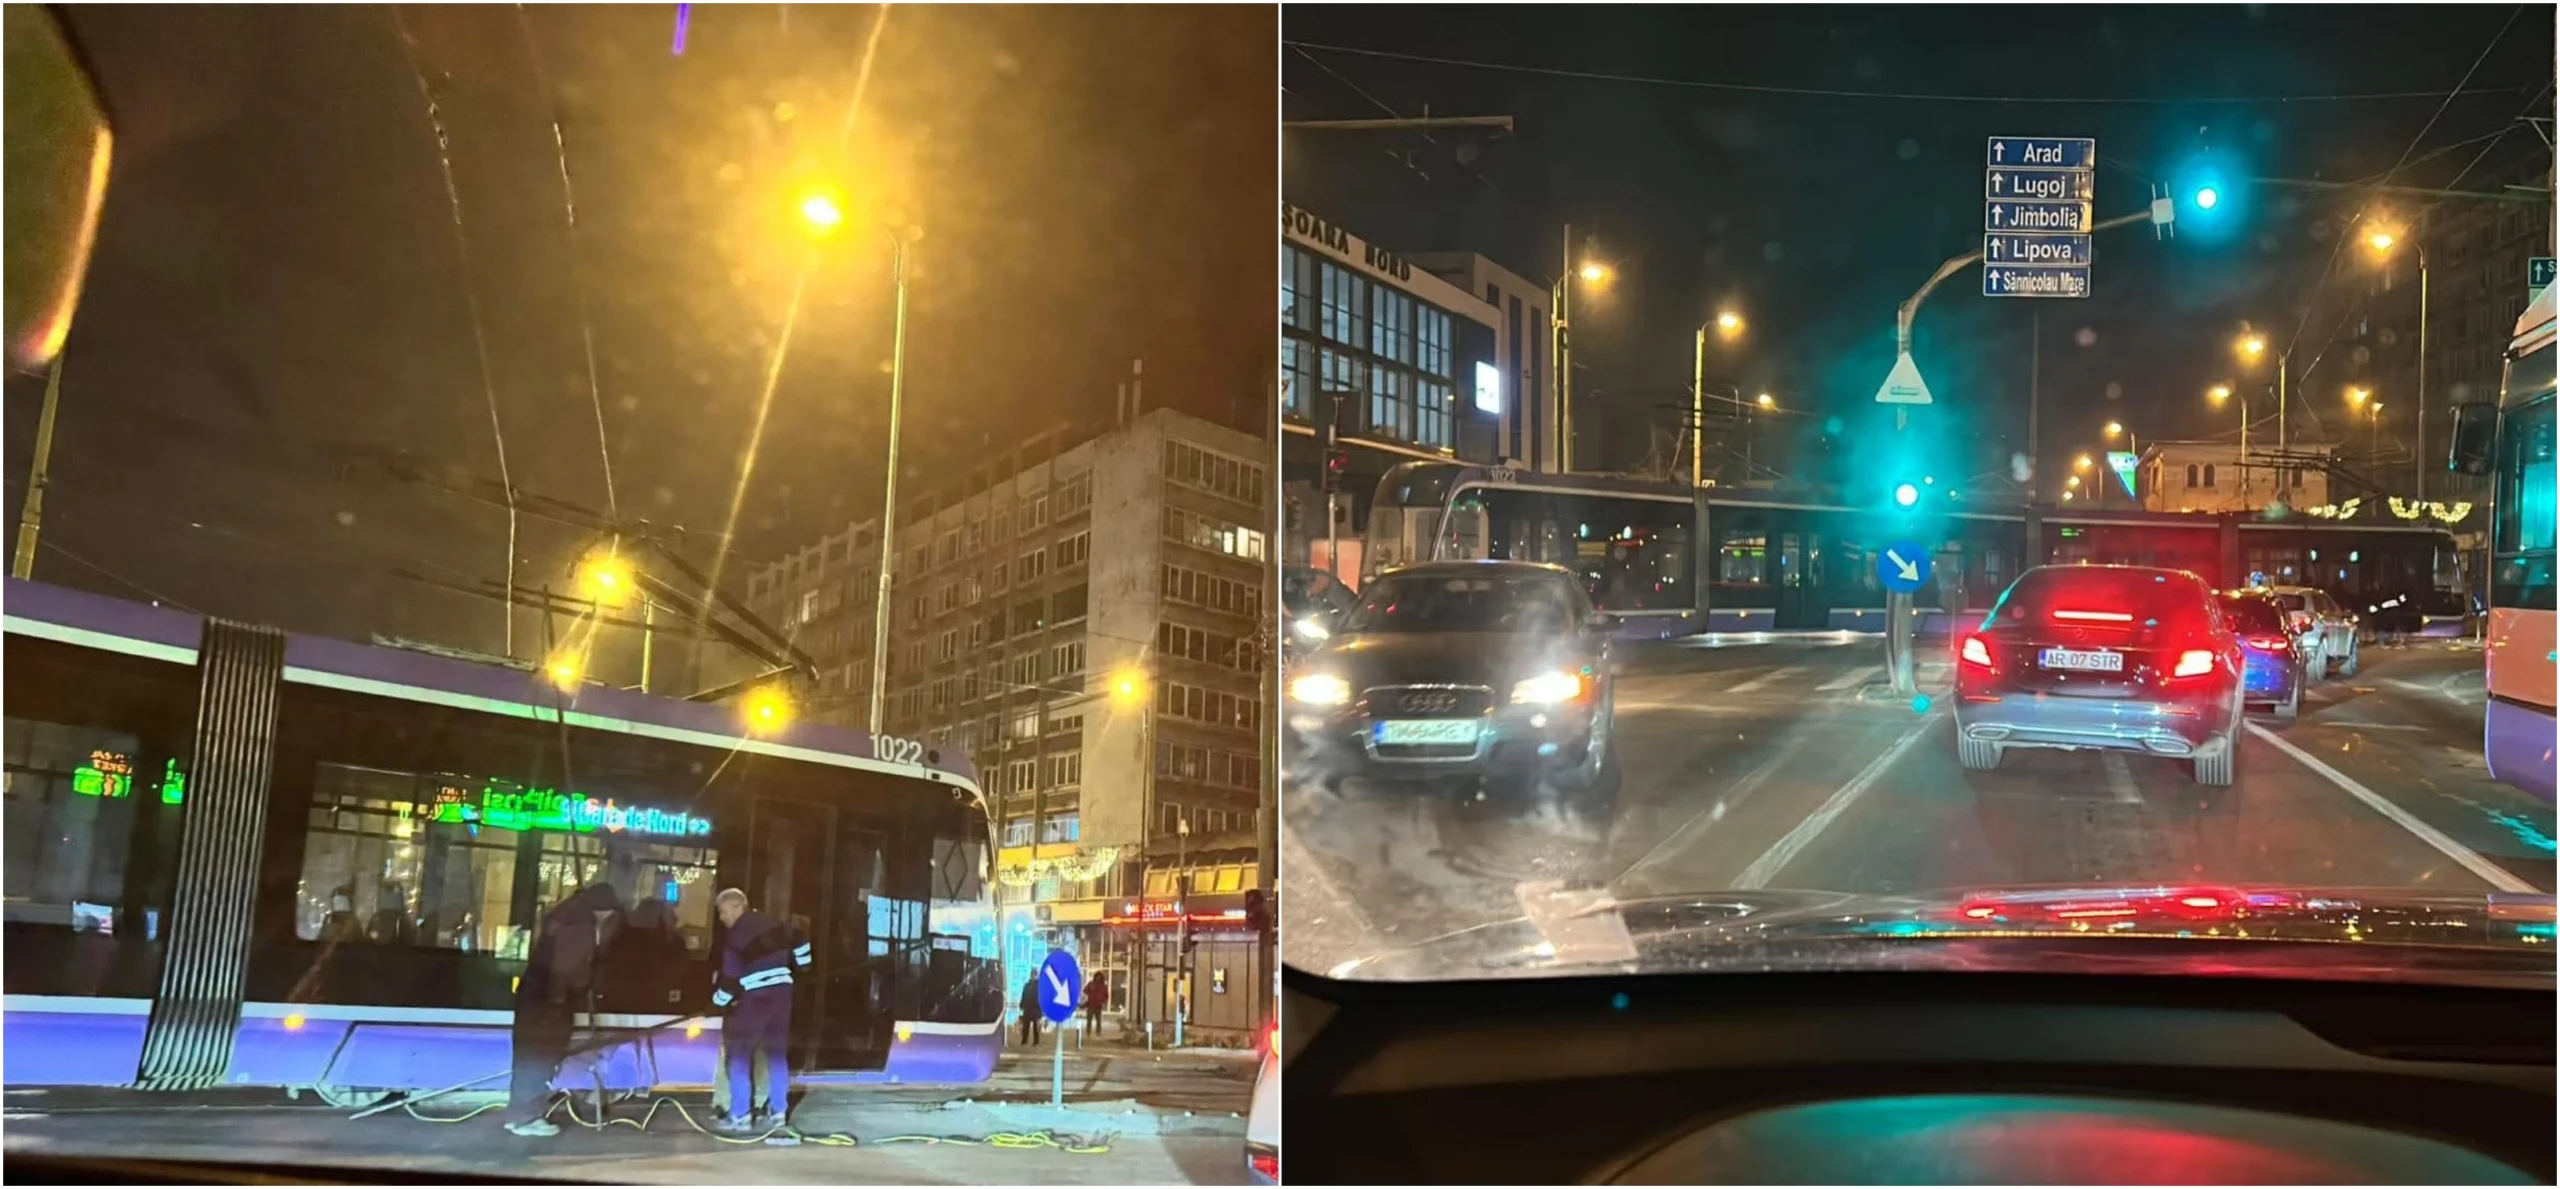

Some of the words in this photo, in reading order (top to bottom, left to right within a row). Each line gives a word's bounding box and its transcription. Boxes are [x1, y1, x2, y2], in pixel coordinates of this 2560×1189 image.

[2023, 143, 2063, 163] Arad
[2013, 175, 2066, 198] Lugoj
[2010, 205, 2079, 227] Jimbolia
[2013, 239, 2072, 262] Lipova
[1365, 243, 1411, 283] NORD
[2060, 271, 2085, 292] Mare
[2047, 652, 2066, 666] AR
[2070, 653, 2087, 667] 07
[2090, 654, 2120, 669] STR
[869, 734, 923, 767] 1022
[647, 807, 687, 836] Nord
